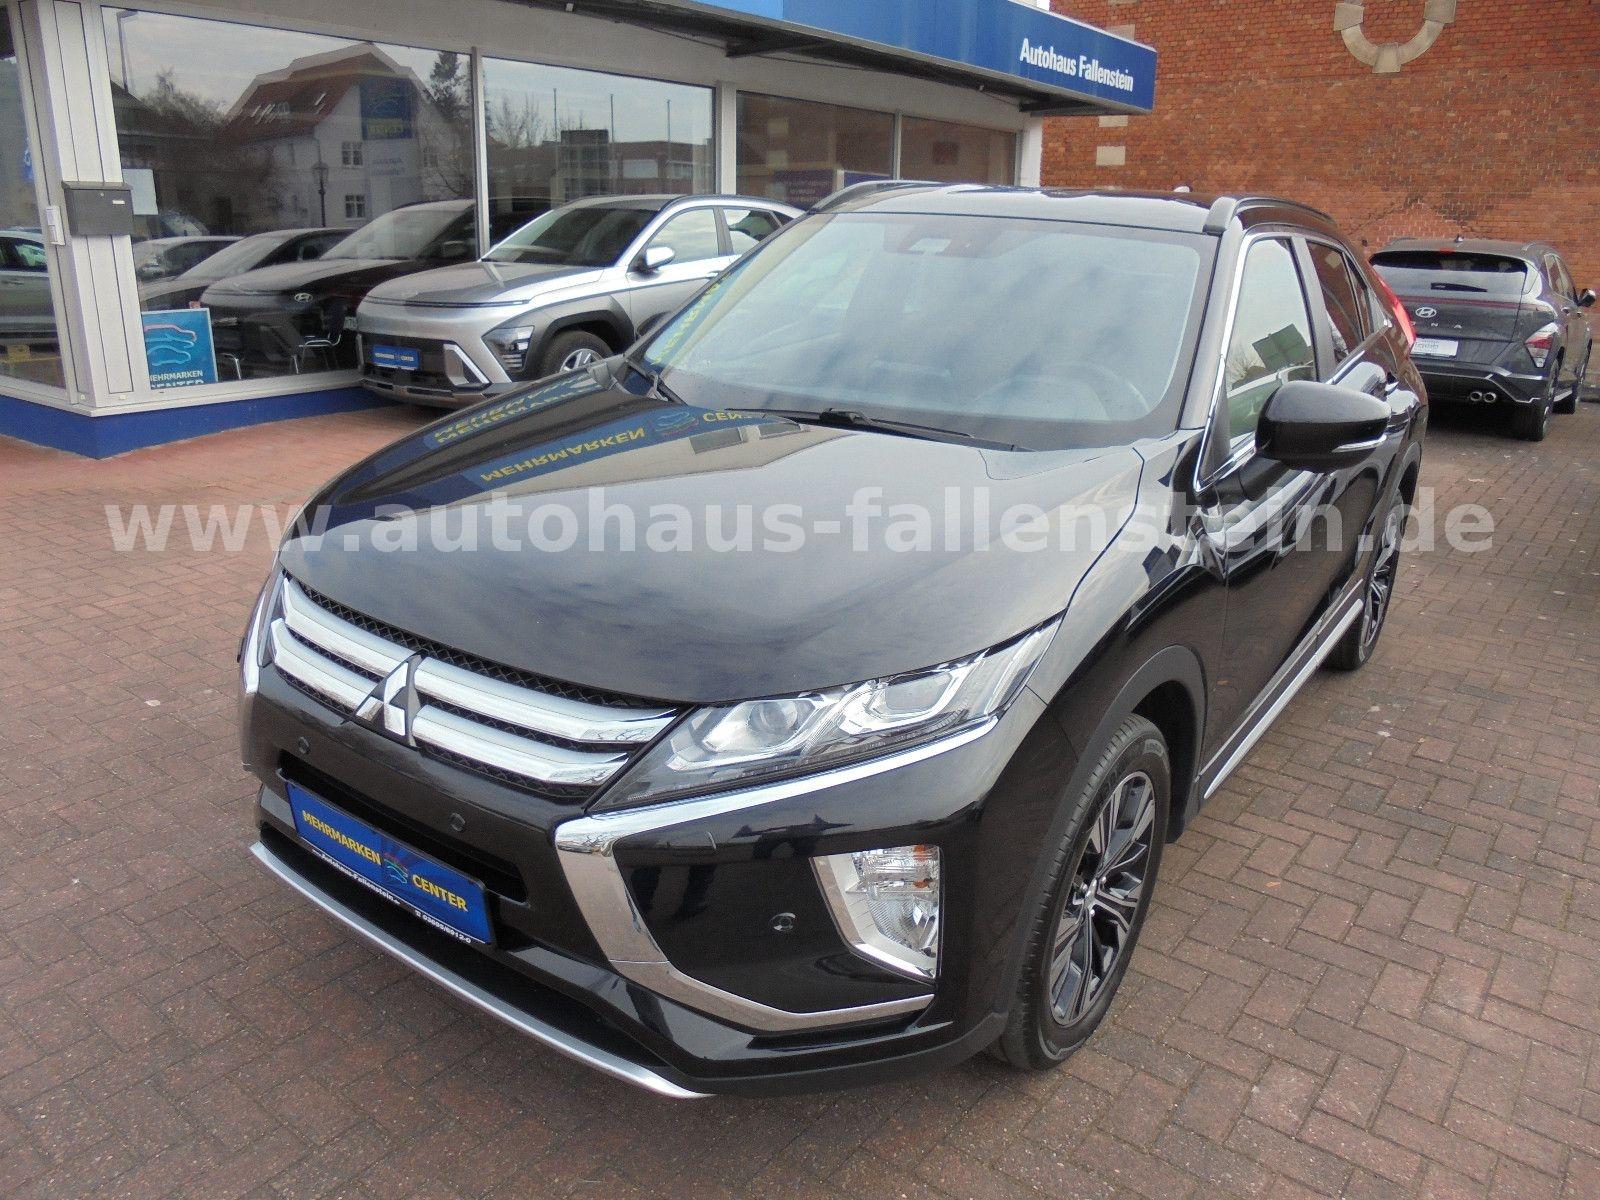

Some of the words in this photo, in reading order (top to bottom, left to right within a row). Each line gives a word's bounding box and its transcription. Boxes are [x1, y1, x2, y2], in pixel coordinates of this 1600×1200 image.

[1019, 37, 1077, 76] Autohaus
[1078, 55, 1134, 92] Fallenstein
[302, 809, 382, 866] MEHRMARKEN
[412, 873, 469, 912] CENTER
